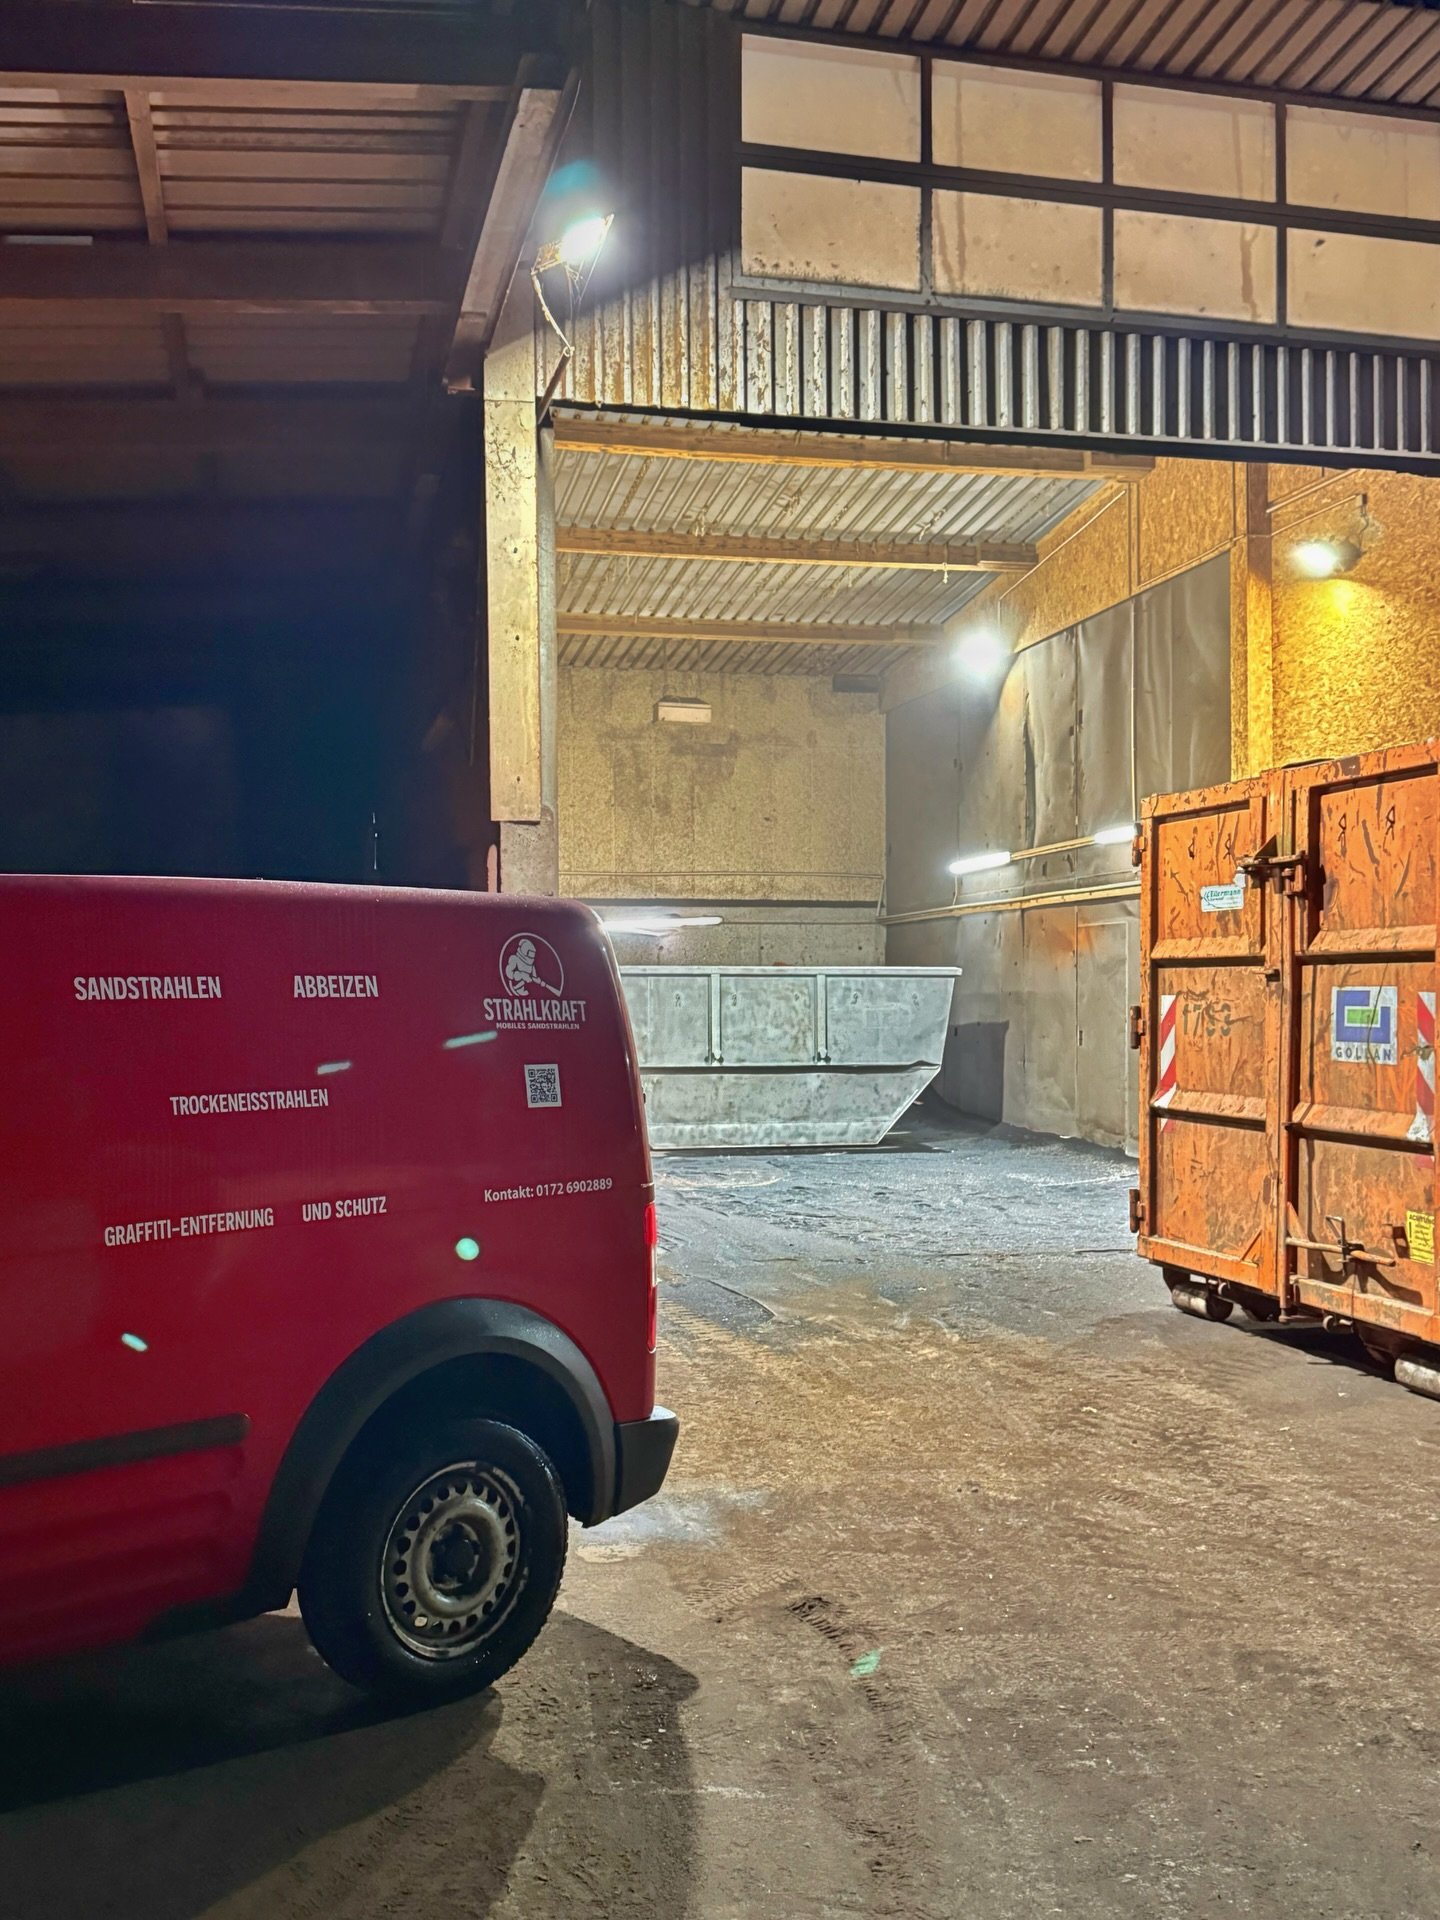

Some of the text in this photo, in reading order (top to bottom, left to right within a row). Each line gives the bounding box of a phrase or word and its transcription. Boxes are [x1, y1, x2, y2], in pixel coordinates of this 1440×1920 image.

[73, 975, 222, 1000] SANDSTRAHLEN
[293, 975, 379, 998] ABBEIZEN
[483, 998, 586, 1022] STRAHLKRAFT
[527, 1022, 580, 1030] SANDSTRAHLEN
[1335, 1046, 1392, 1061] GOLLAN
[169, 1088, 329, 1116] TROCKENEISSTRAHLEN
[484, 1178, 613, 1203] Kontakt: 0172 6902889
[104, 1196, 388, 1247] GRAFFITI-ENTFERNUNG UND SCHUTZ
